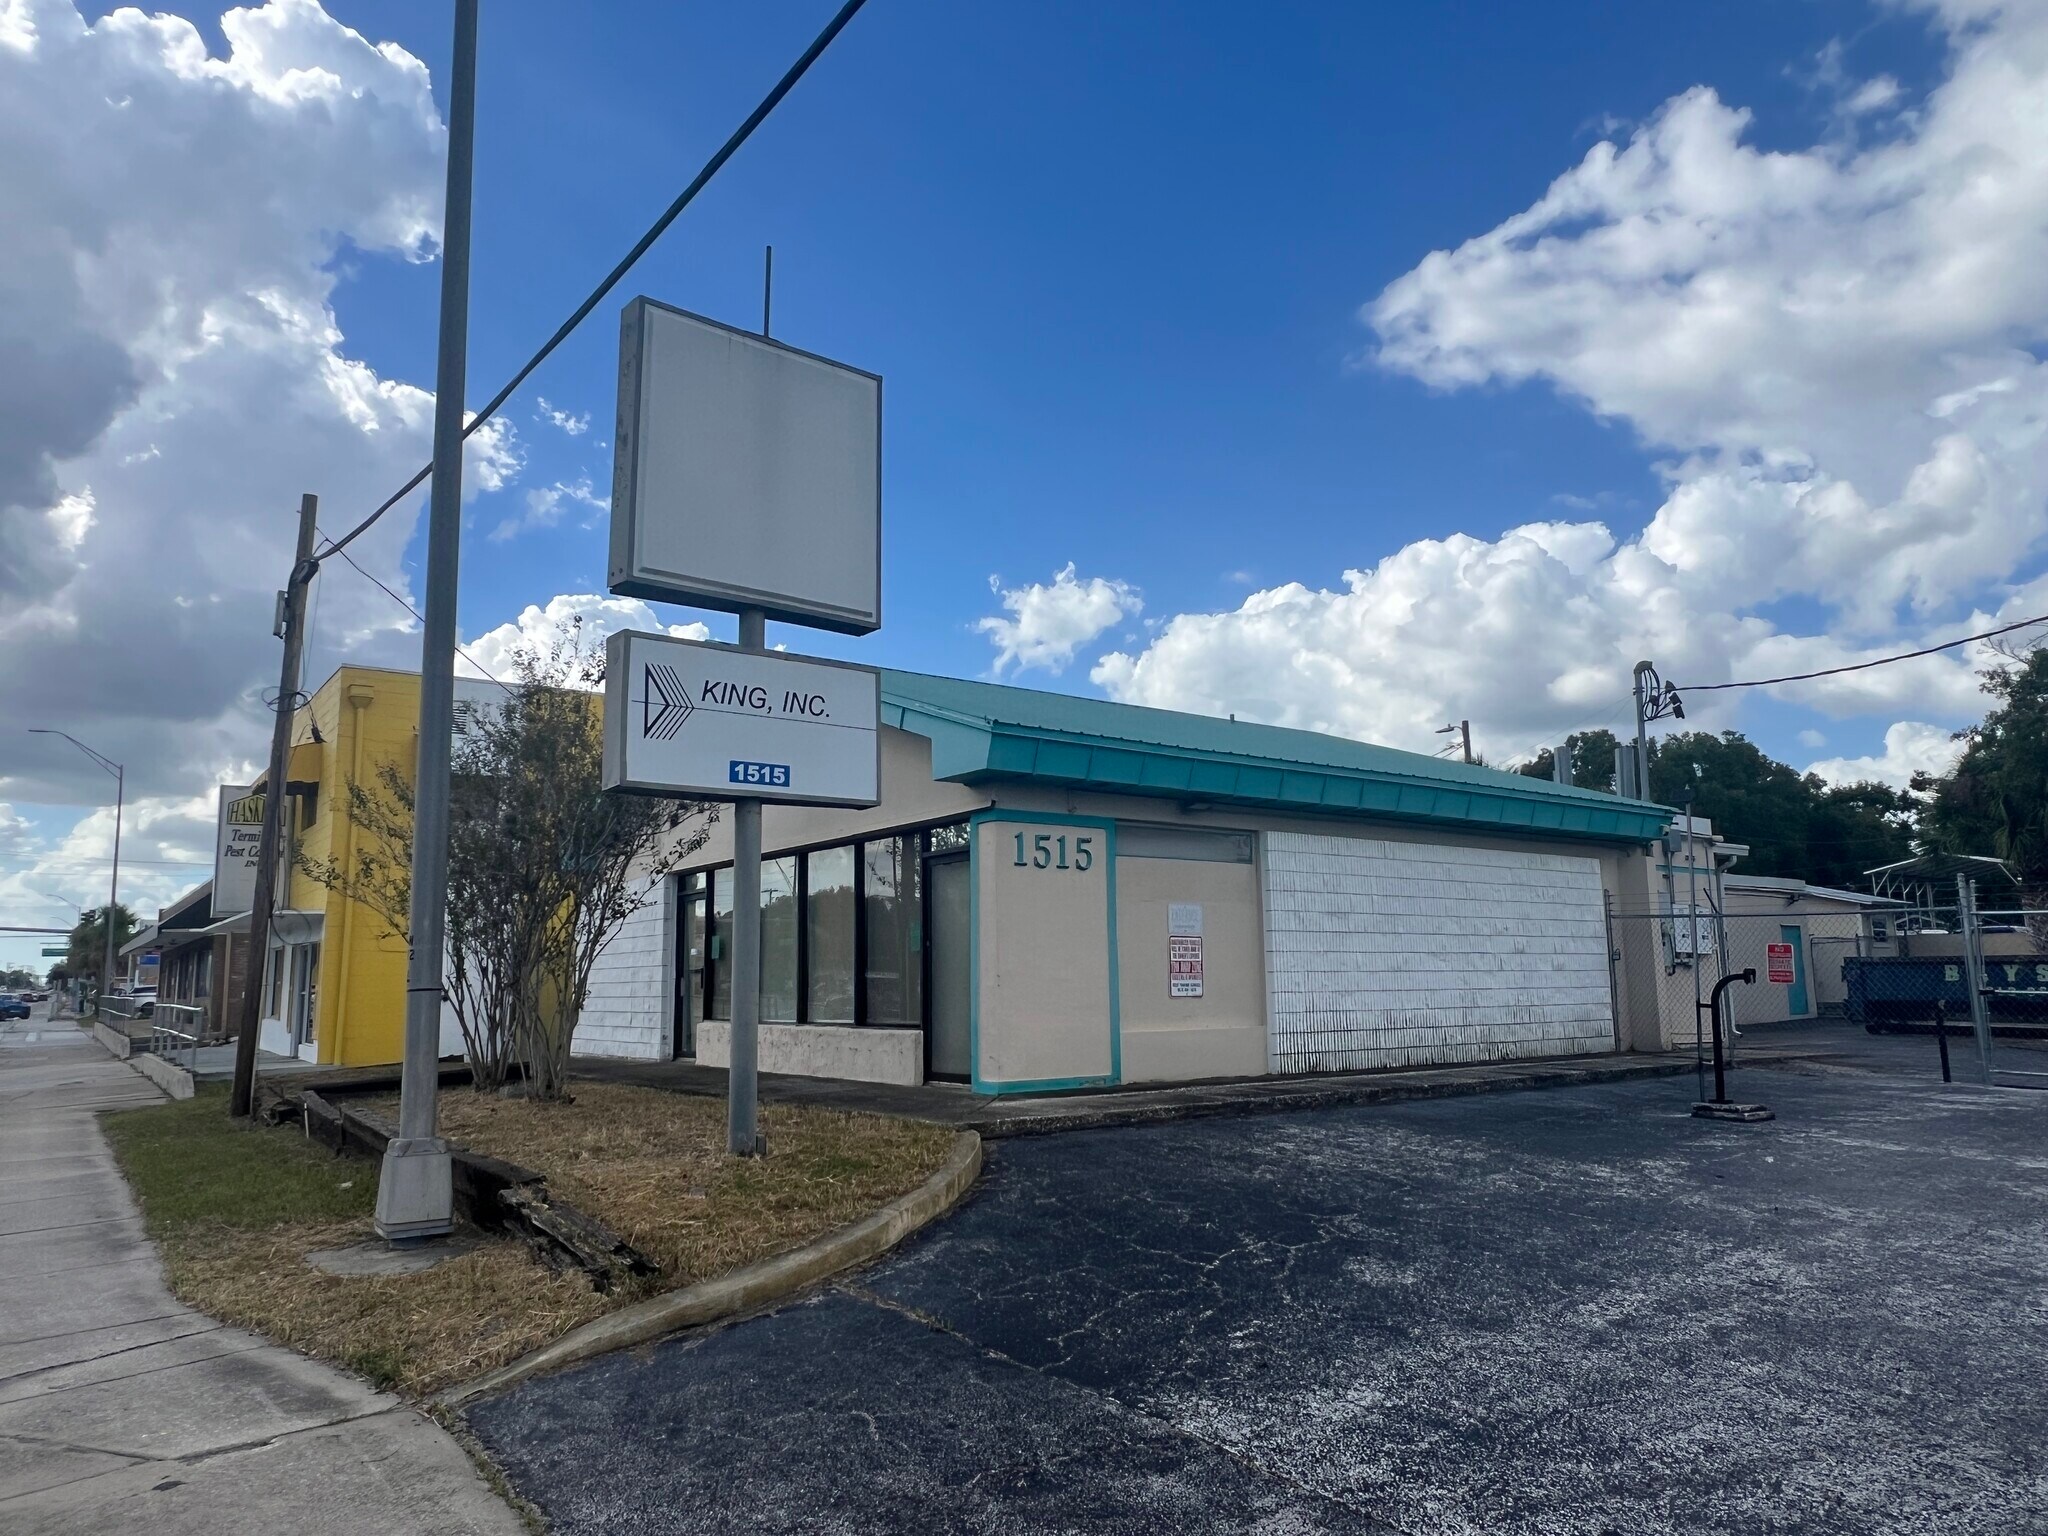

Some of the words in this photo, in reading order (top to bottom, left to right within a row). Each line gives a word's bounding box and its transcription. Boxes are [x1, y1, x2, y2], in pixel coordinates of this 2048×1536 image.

[701, 680, 773, 714] KING,
[782, 691, 830, 718] INC.
[734, 764, 785, 784] 1515
[224, 845, 245, 857] Pest
[1014, 831, 1092, 871] 1515
